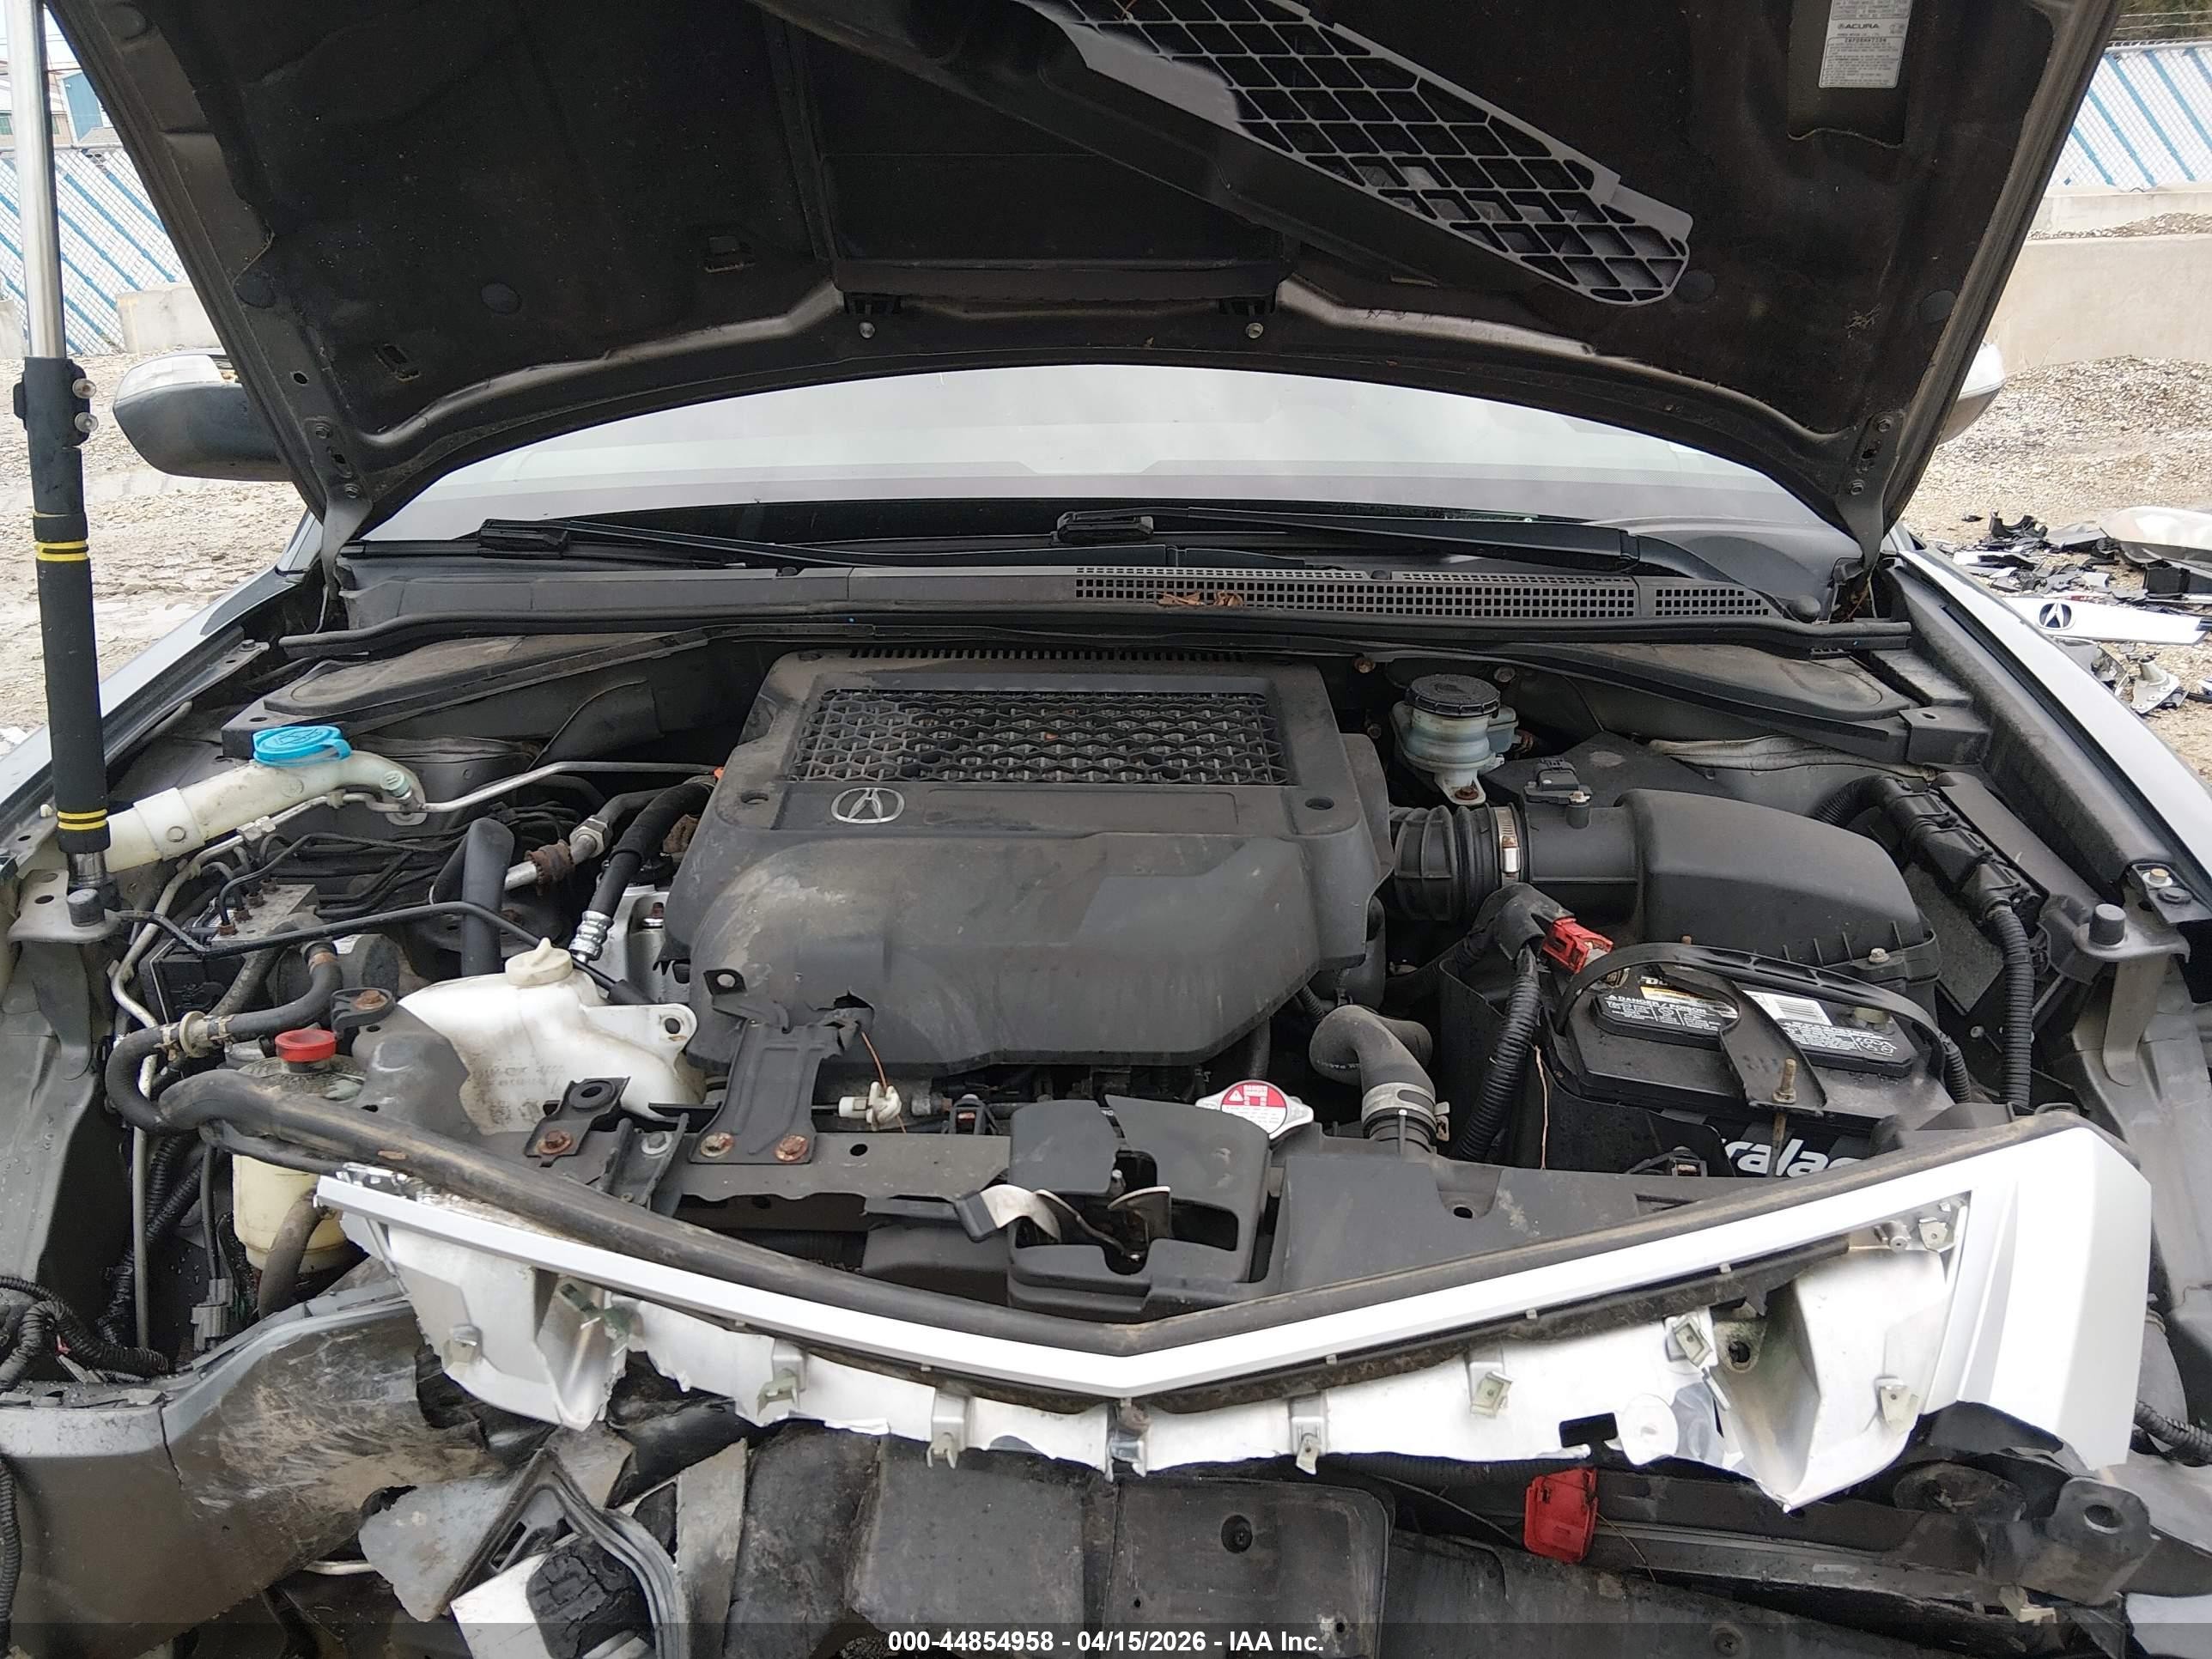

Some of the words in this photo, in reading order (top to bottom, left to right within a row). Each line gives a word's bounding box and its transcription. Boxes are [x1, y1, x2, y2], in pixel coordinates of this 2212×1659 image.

[1618, 995, 1660, 1007] DANGER
[1668, 1003, 1707, 1015] POISON
[1722, 1138, 1863, 1178] rala
